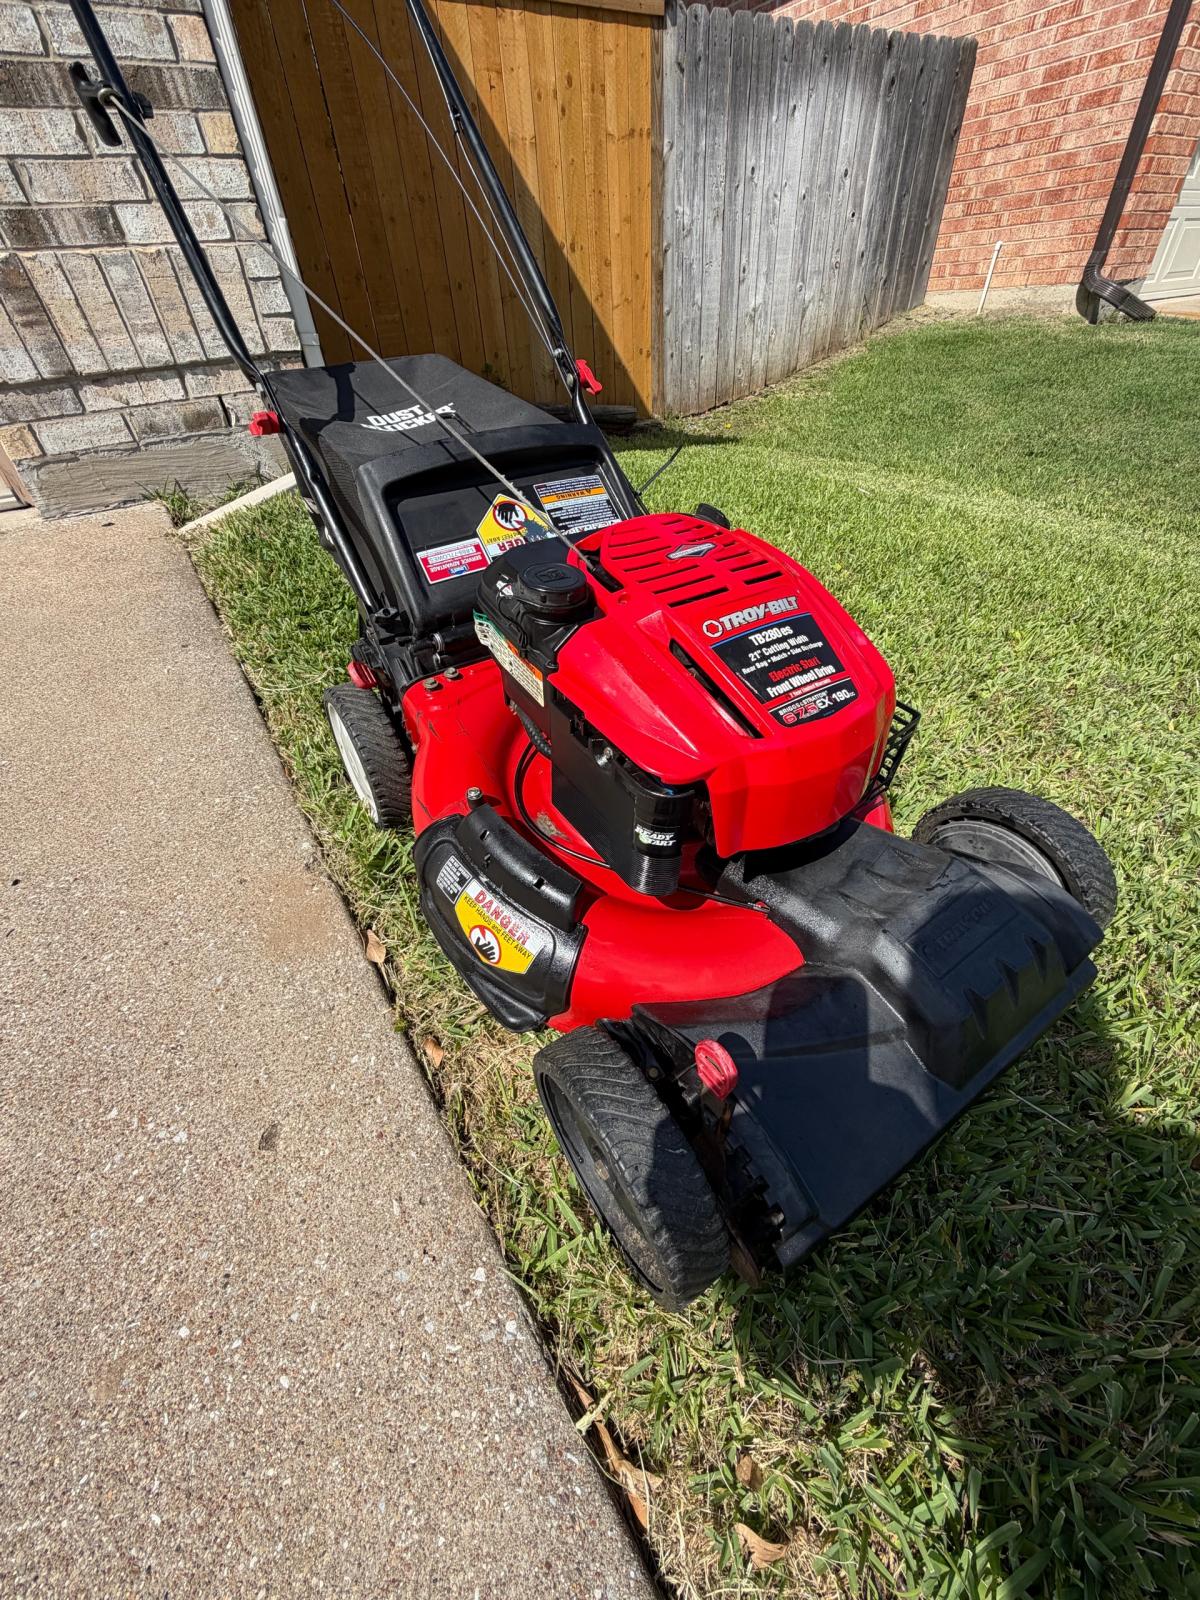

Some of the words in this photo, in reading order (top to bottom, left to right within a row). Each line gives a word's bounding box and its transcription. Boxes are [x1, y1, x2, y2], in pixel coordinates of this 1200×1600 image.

[366, 405, 423, 426] DUST
[429, 560, 461, 573] ADVANTAGE
[461, 554, 483, 565] SERVICE
[719, 596, 799, 631] TROY-BILT
[763, 640, 789, 657] Cutting
[787, 634, 809, 647] Width
[766, 680, 792, 698] Front
[788, 669, 817, 689] Wheel
[814, 663, 836, 678] Drive
[768, 662, 801, 683] Electric
[799, 656, 822, 673] Start
[778, 702, 801, 716] BRIGGS
[463, 895, 478, 910] KEEP
[475, 907, 492, 926] HANDS
[500, 931, 515, 946] FEET
[514, 944, 531, 960] AWAY
